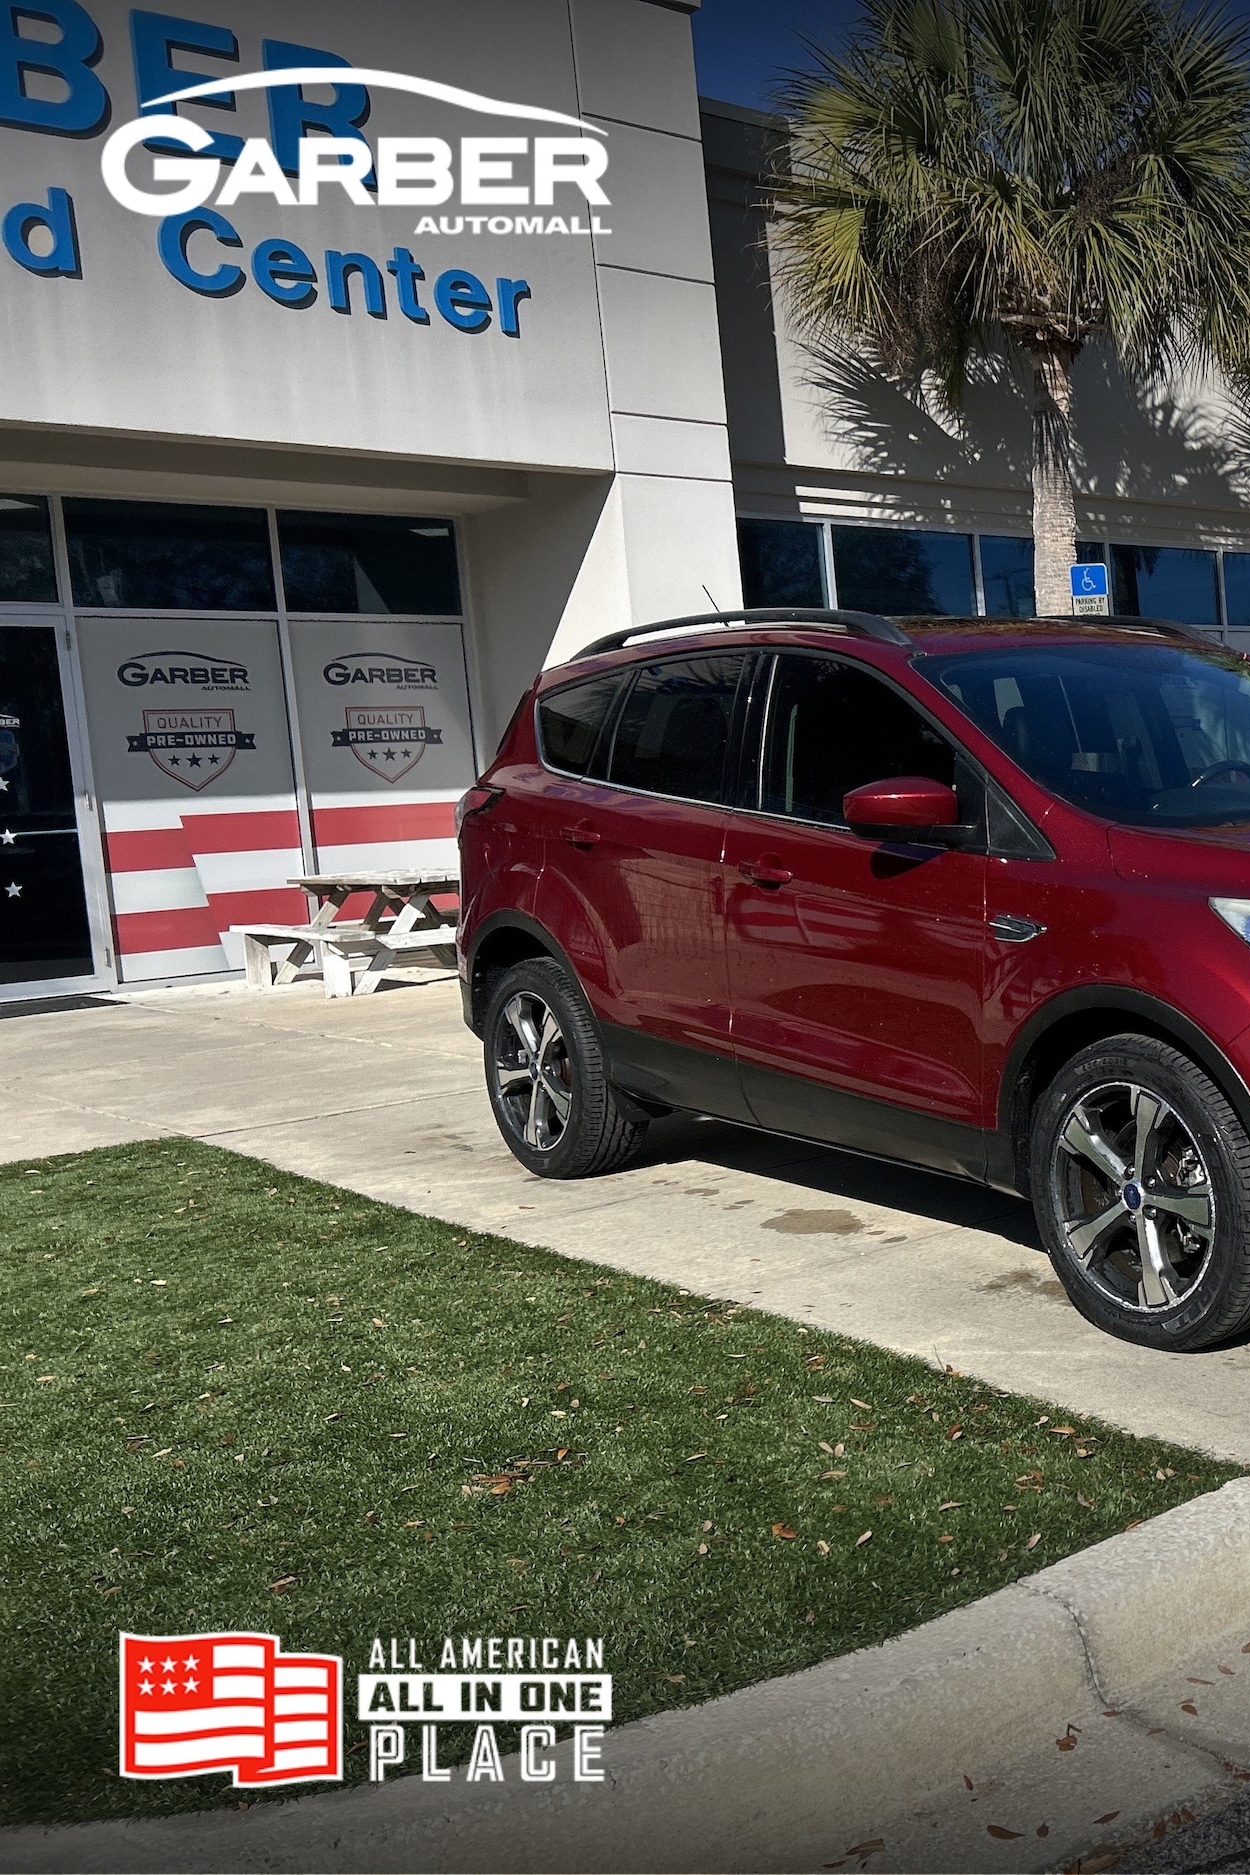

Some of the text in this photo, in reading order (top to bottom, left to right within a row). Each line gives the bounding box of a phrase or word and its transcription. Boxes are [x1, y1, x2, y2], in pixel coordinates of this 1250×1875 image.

[156, 205, 531, 338] Center
[1075, 597, 1097, 605] PARKING
[1079, 604, 1104, 612] DISABLED
[117, 662, 249, 687] GARBER
[323, 662, 438, 686] GARBER
[157, 716, 222, 729] QUALITY
[357, 713, 414, 725] QUALITY
[146, 734, 237, 747] PRE-OWNED
[348, 729, 426, 742] PRE-OWNED
